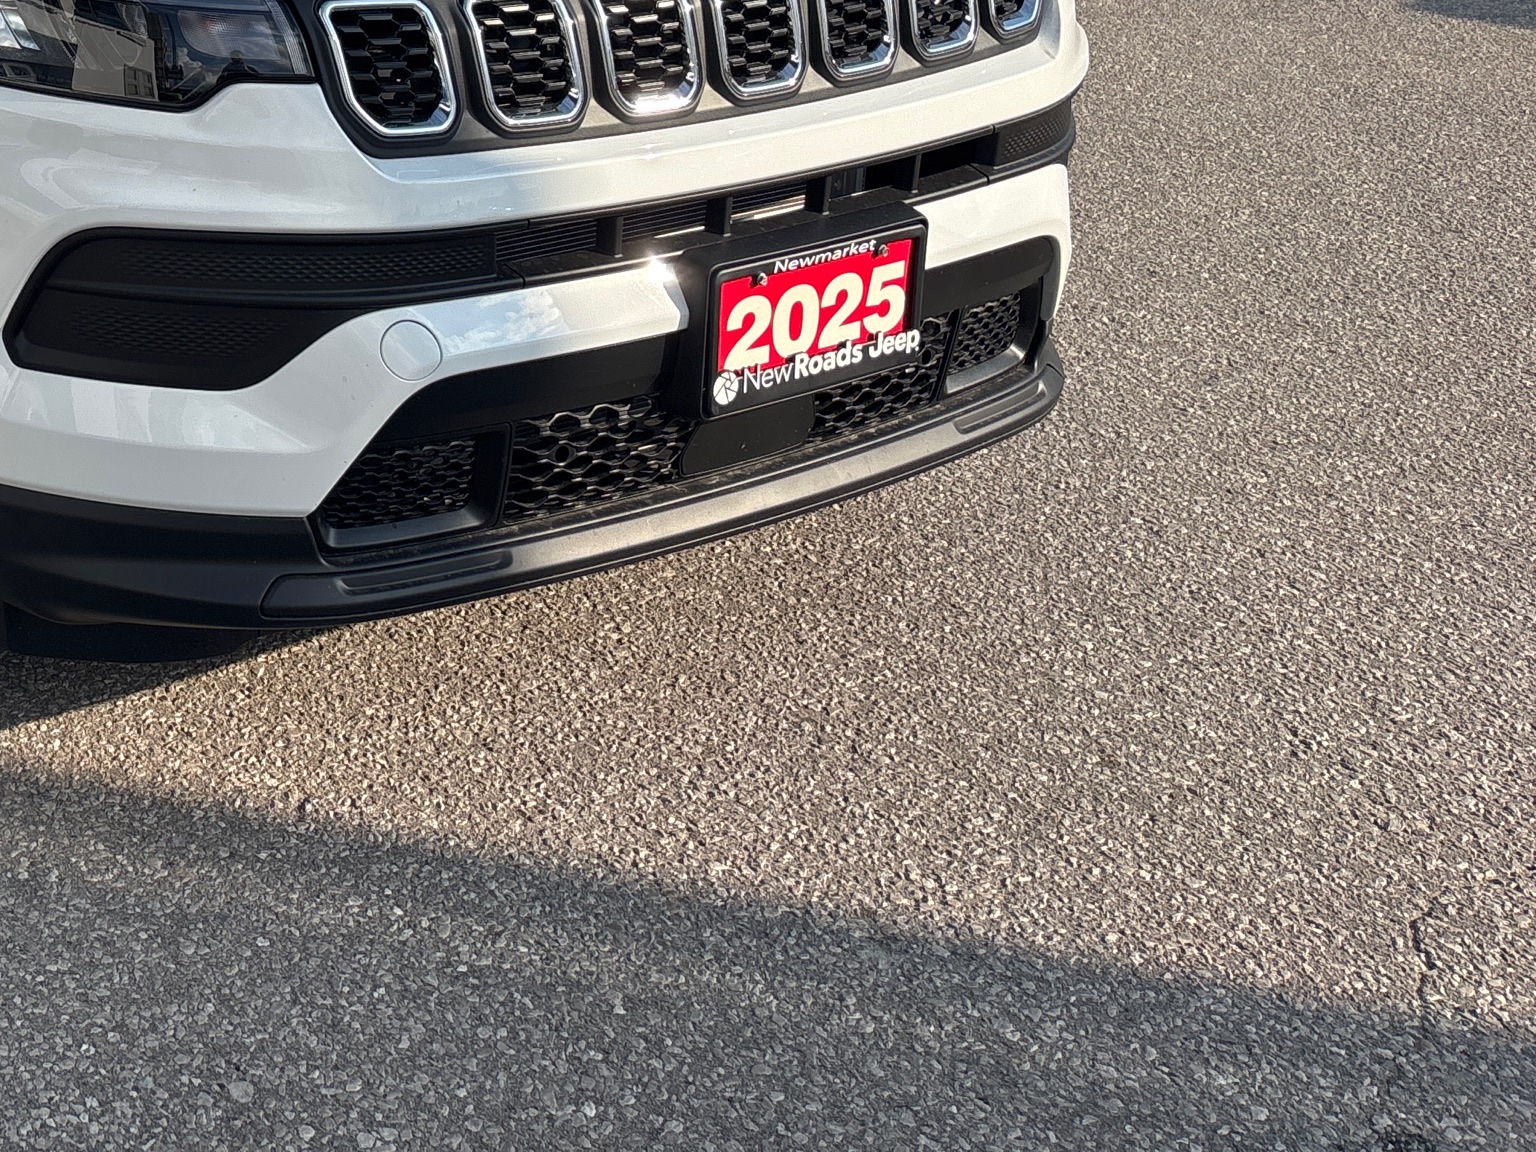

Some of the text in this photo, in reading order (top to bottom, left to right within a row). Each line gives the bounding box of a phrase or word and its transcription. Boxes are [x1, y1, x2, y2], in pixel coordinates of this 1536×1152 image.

[773, 239, 877, 275] Newmarket
[723, 260, 906, 371] 2025
[868, 329, 920, 357] Jeep
